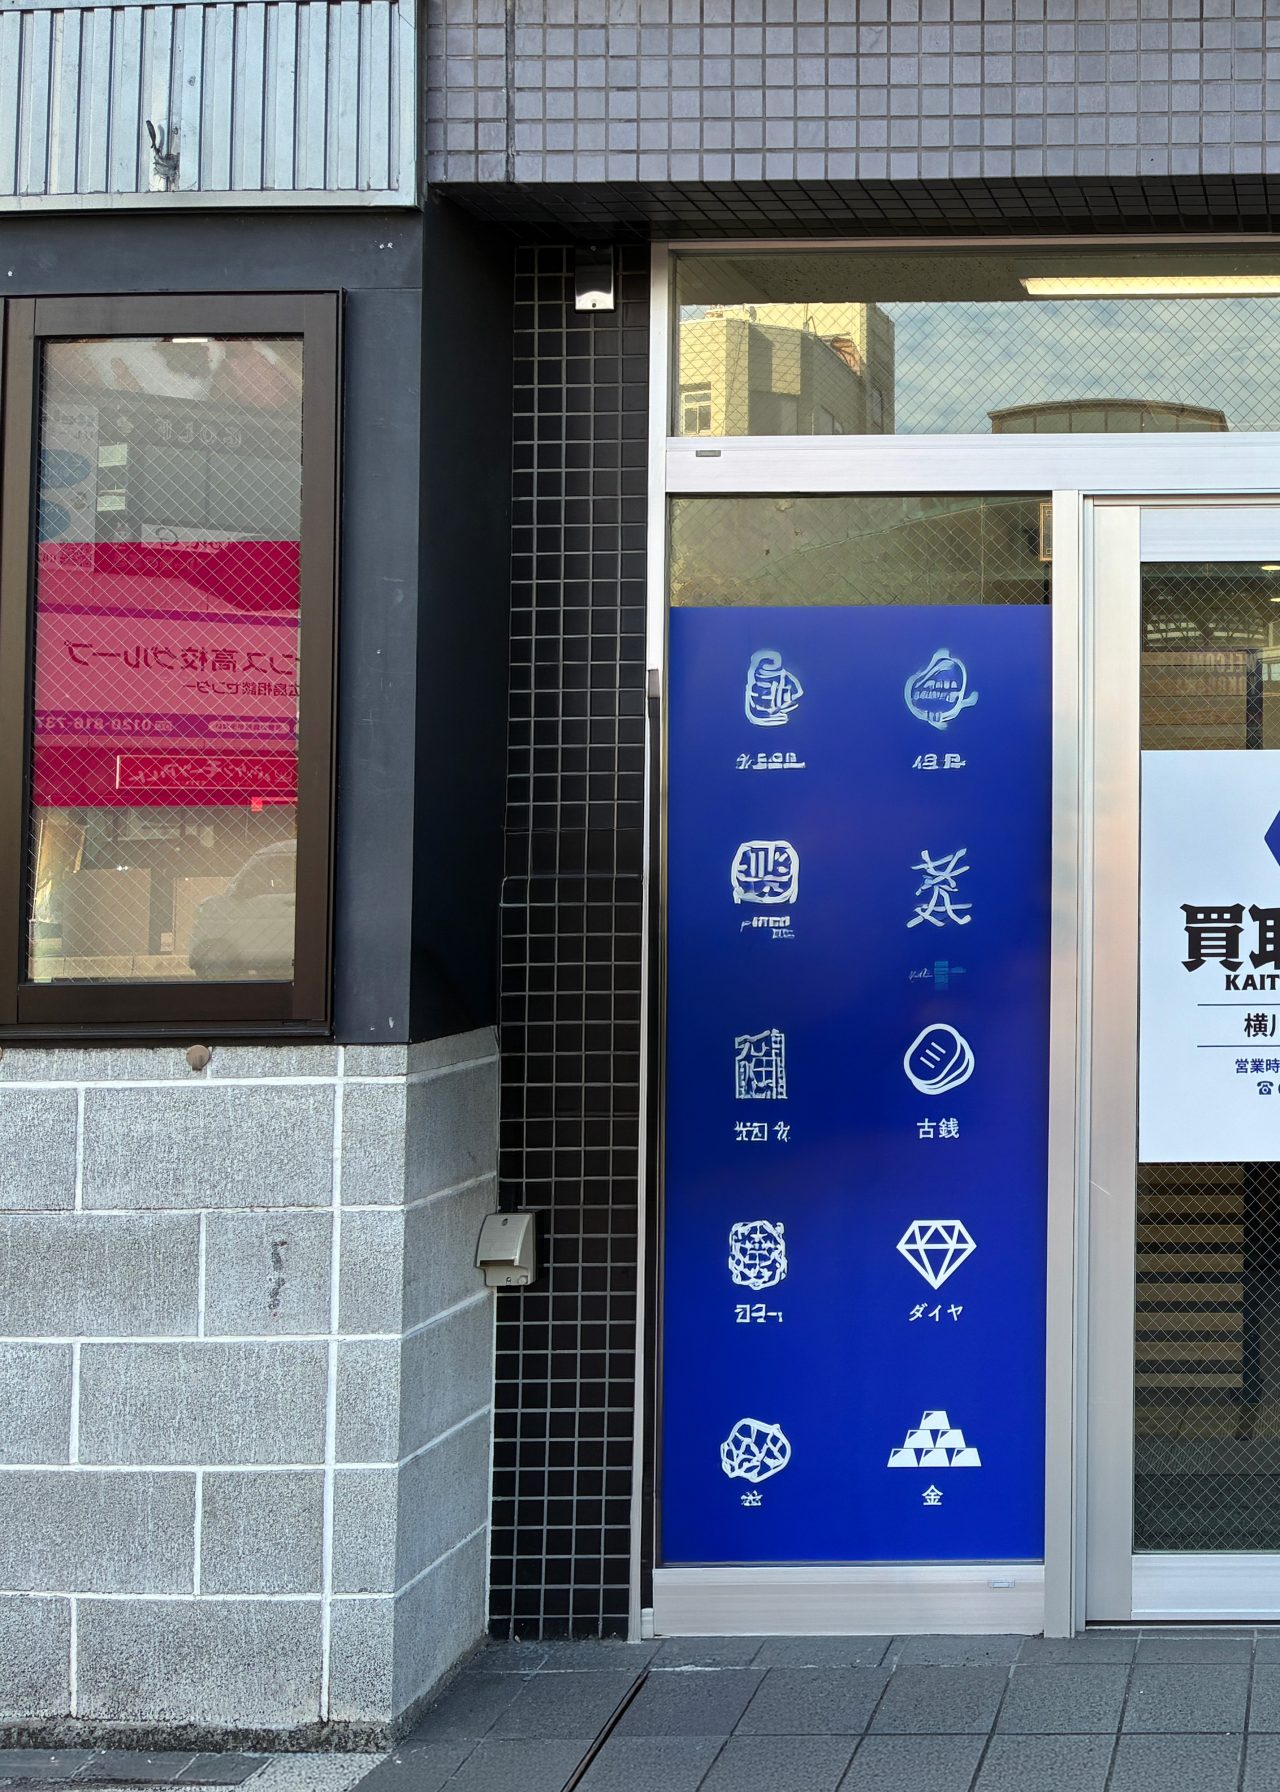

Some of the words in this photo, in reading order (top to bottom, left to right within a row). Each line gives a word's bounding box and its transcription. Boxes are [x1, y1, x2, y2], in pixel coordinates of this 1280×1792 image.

[916, 1117, 960, 1139] 古銭
[908, 1302, 963, 1322] ダイヤ
[921, 1484, 944, 1506] 金
